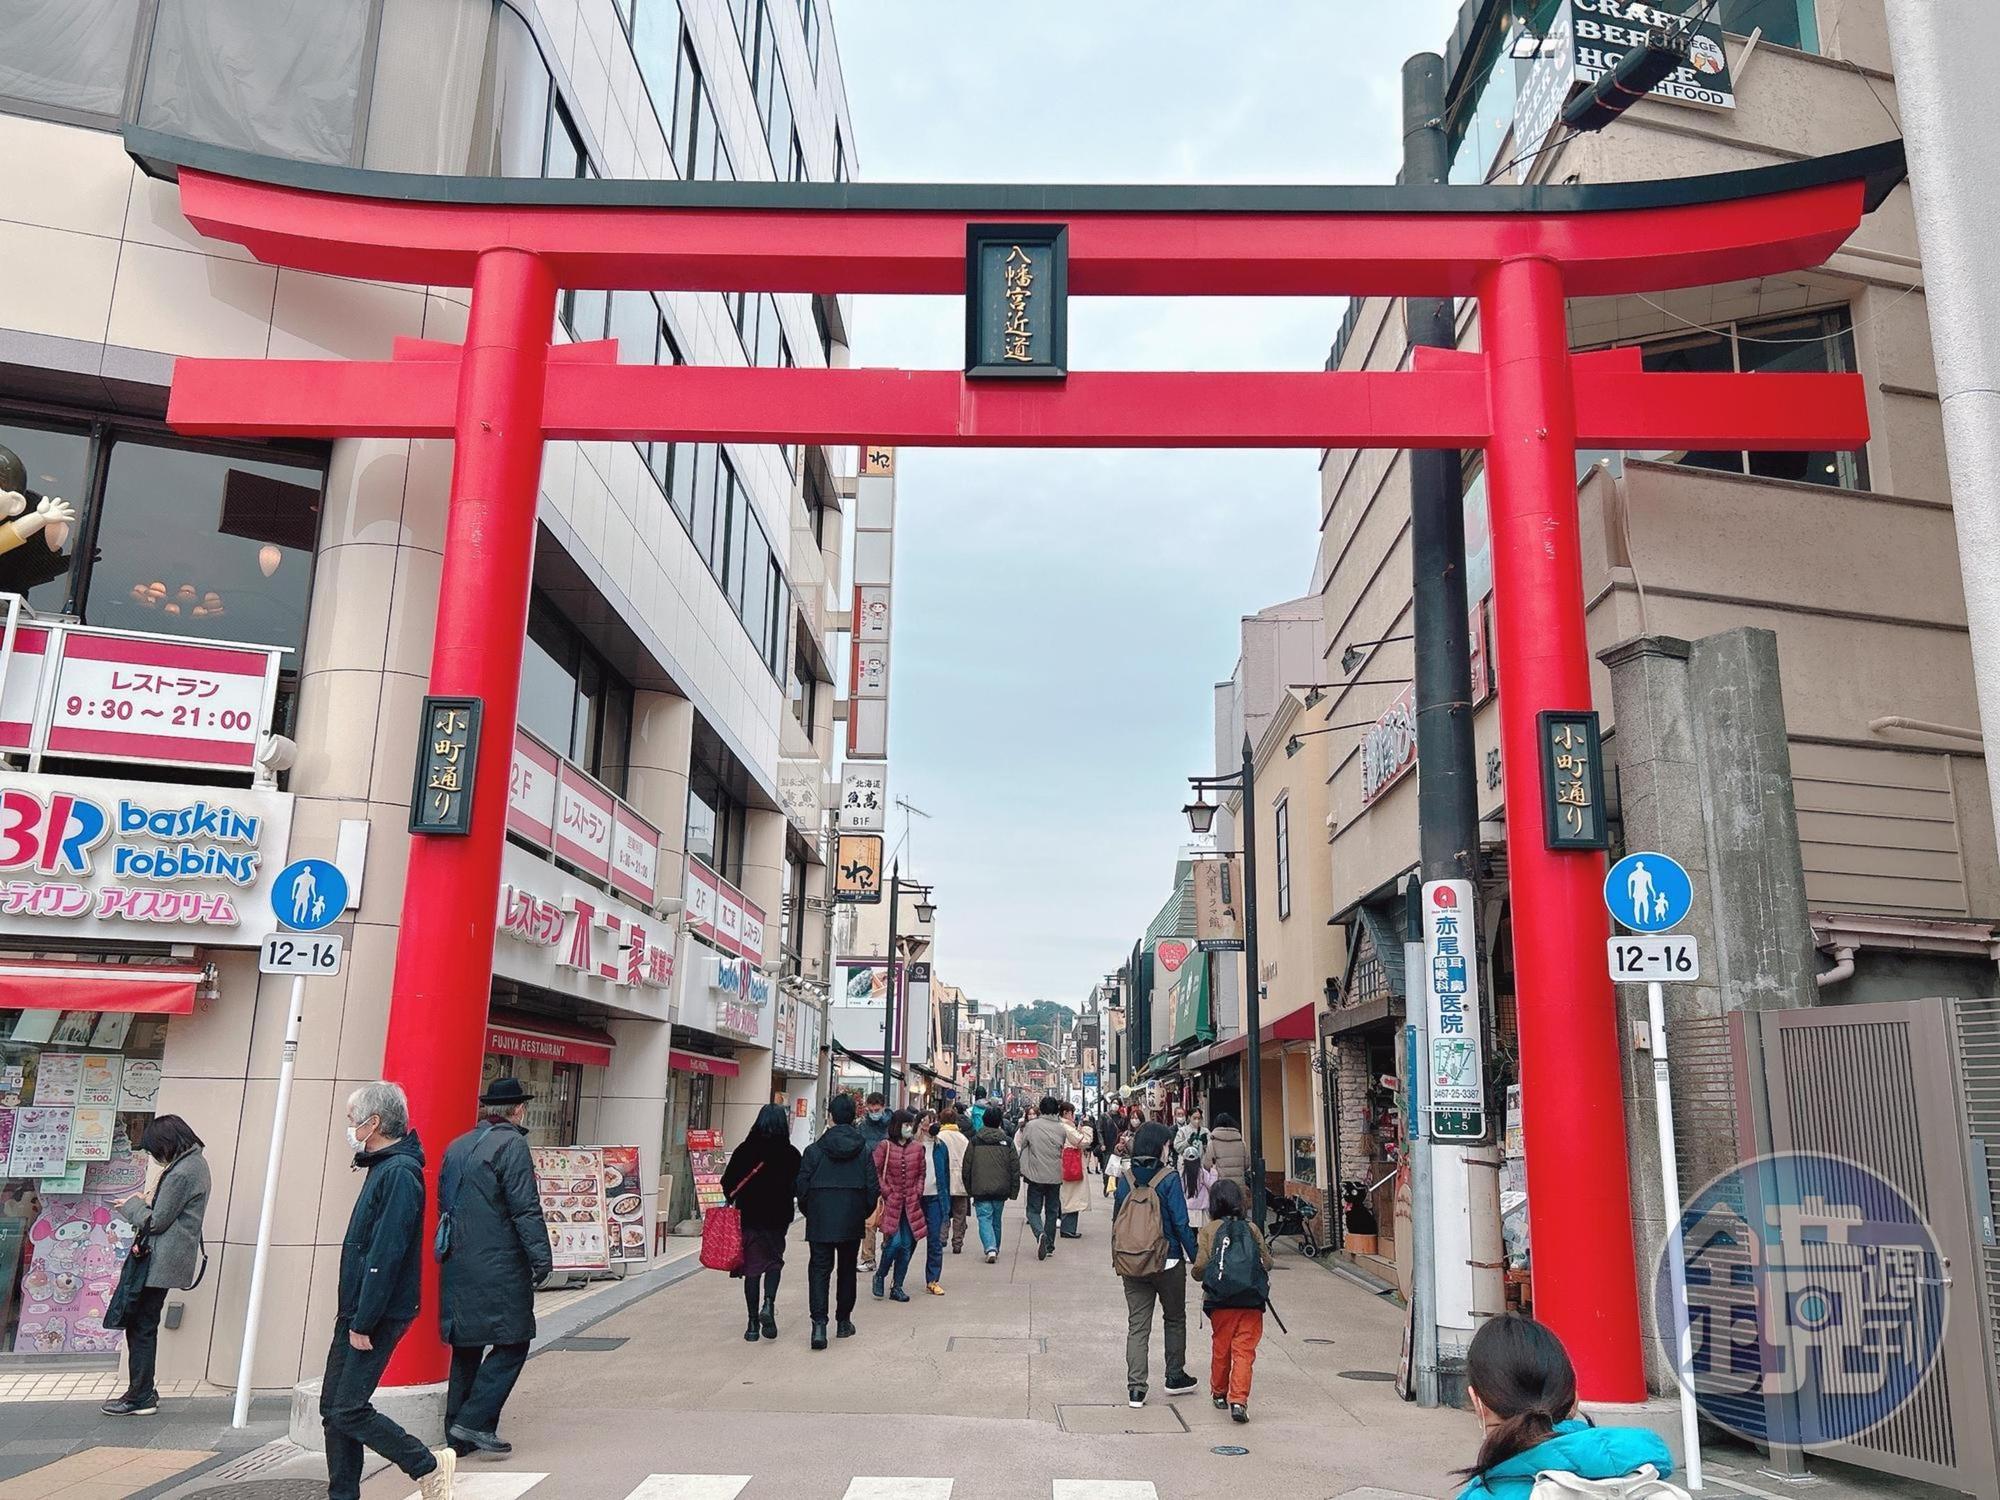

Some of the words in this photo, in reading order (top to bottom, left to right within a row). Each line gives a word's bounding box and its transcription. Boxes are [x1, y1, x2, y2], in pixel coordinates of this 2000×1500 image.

[1673, 85, 1724, 105] FOOD
[1003, 245, 1034, 363] 八幡宮近道
[111, 671, 220, 698] レストラン
[428, 710, 467, 820] 小町通り
[510, 762, 533, 800] 2F
[1553, 725, 1592, 838] 小町通り
[855, 779, 881, 789] 北海道
[120, 800, 257, 845] baskin
[562, 794, 607, 844] レストラン
[853, 816, 870, 826] B1F
[116, 847, 258, 882] robbins
[840, 859, 874, 889] わん
[100, 889, 235, 922] アイスクリーム
[695, 887, 706, 911] 2F
[504, 884, 567, 944] レストラン
[569, 897, 647, 988] 不二家
[1435, 915, 1460, 956] 赤尾
[268, 940, 336, 968] 12-16
[1616, 945, 1692, 973] 12-16
[1448, 956, 1466, 993] 耳鼻
[1439, 994, 1464, 1034] 医院
[491, 1034, 521, 1051] FUJIYA
[519, 1038, 566, 1057] RESTAURANT
[1434, 1088, 1480, 1099] 0467-25-3387
[1446, 1121, 1469, 1131] 1-5
